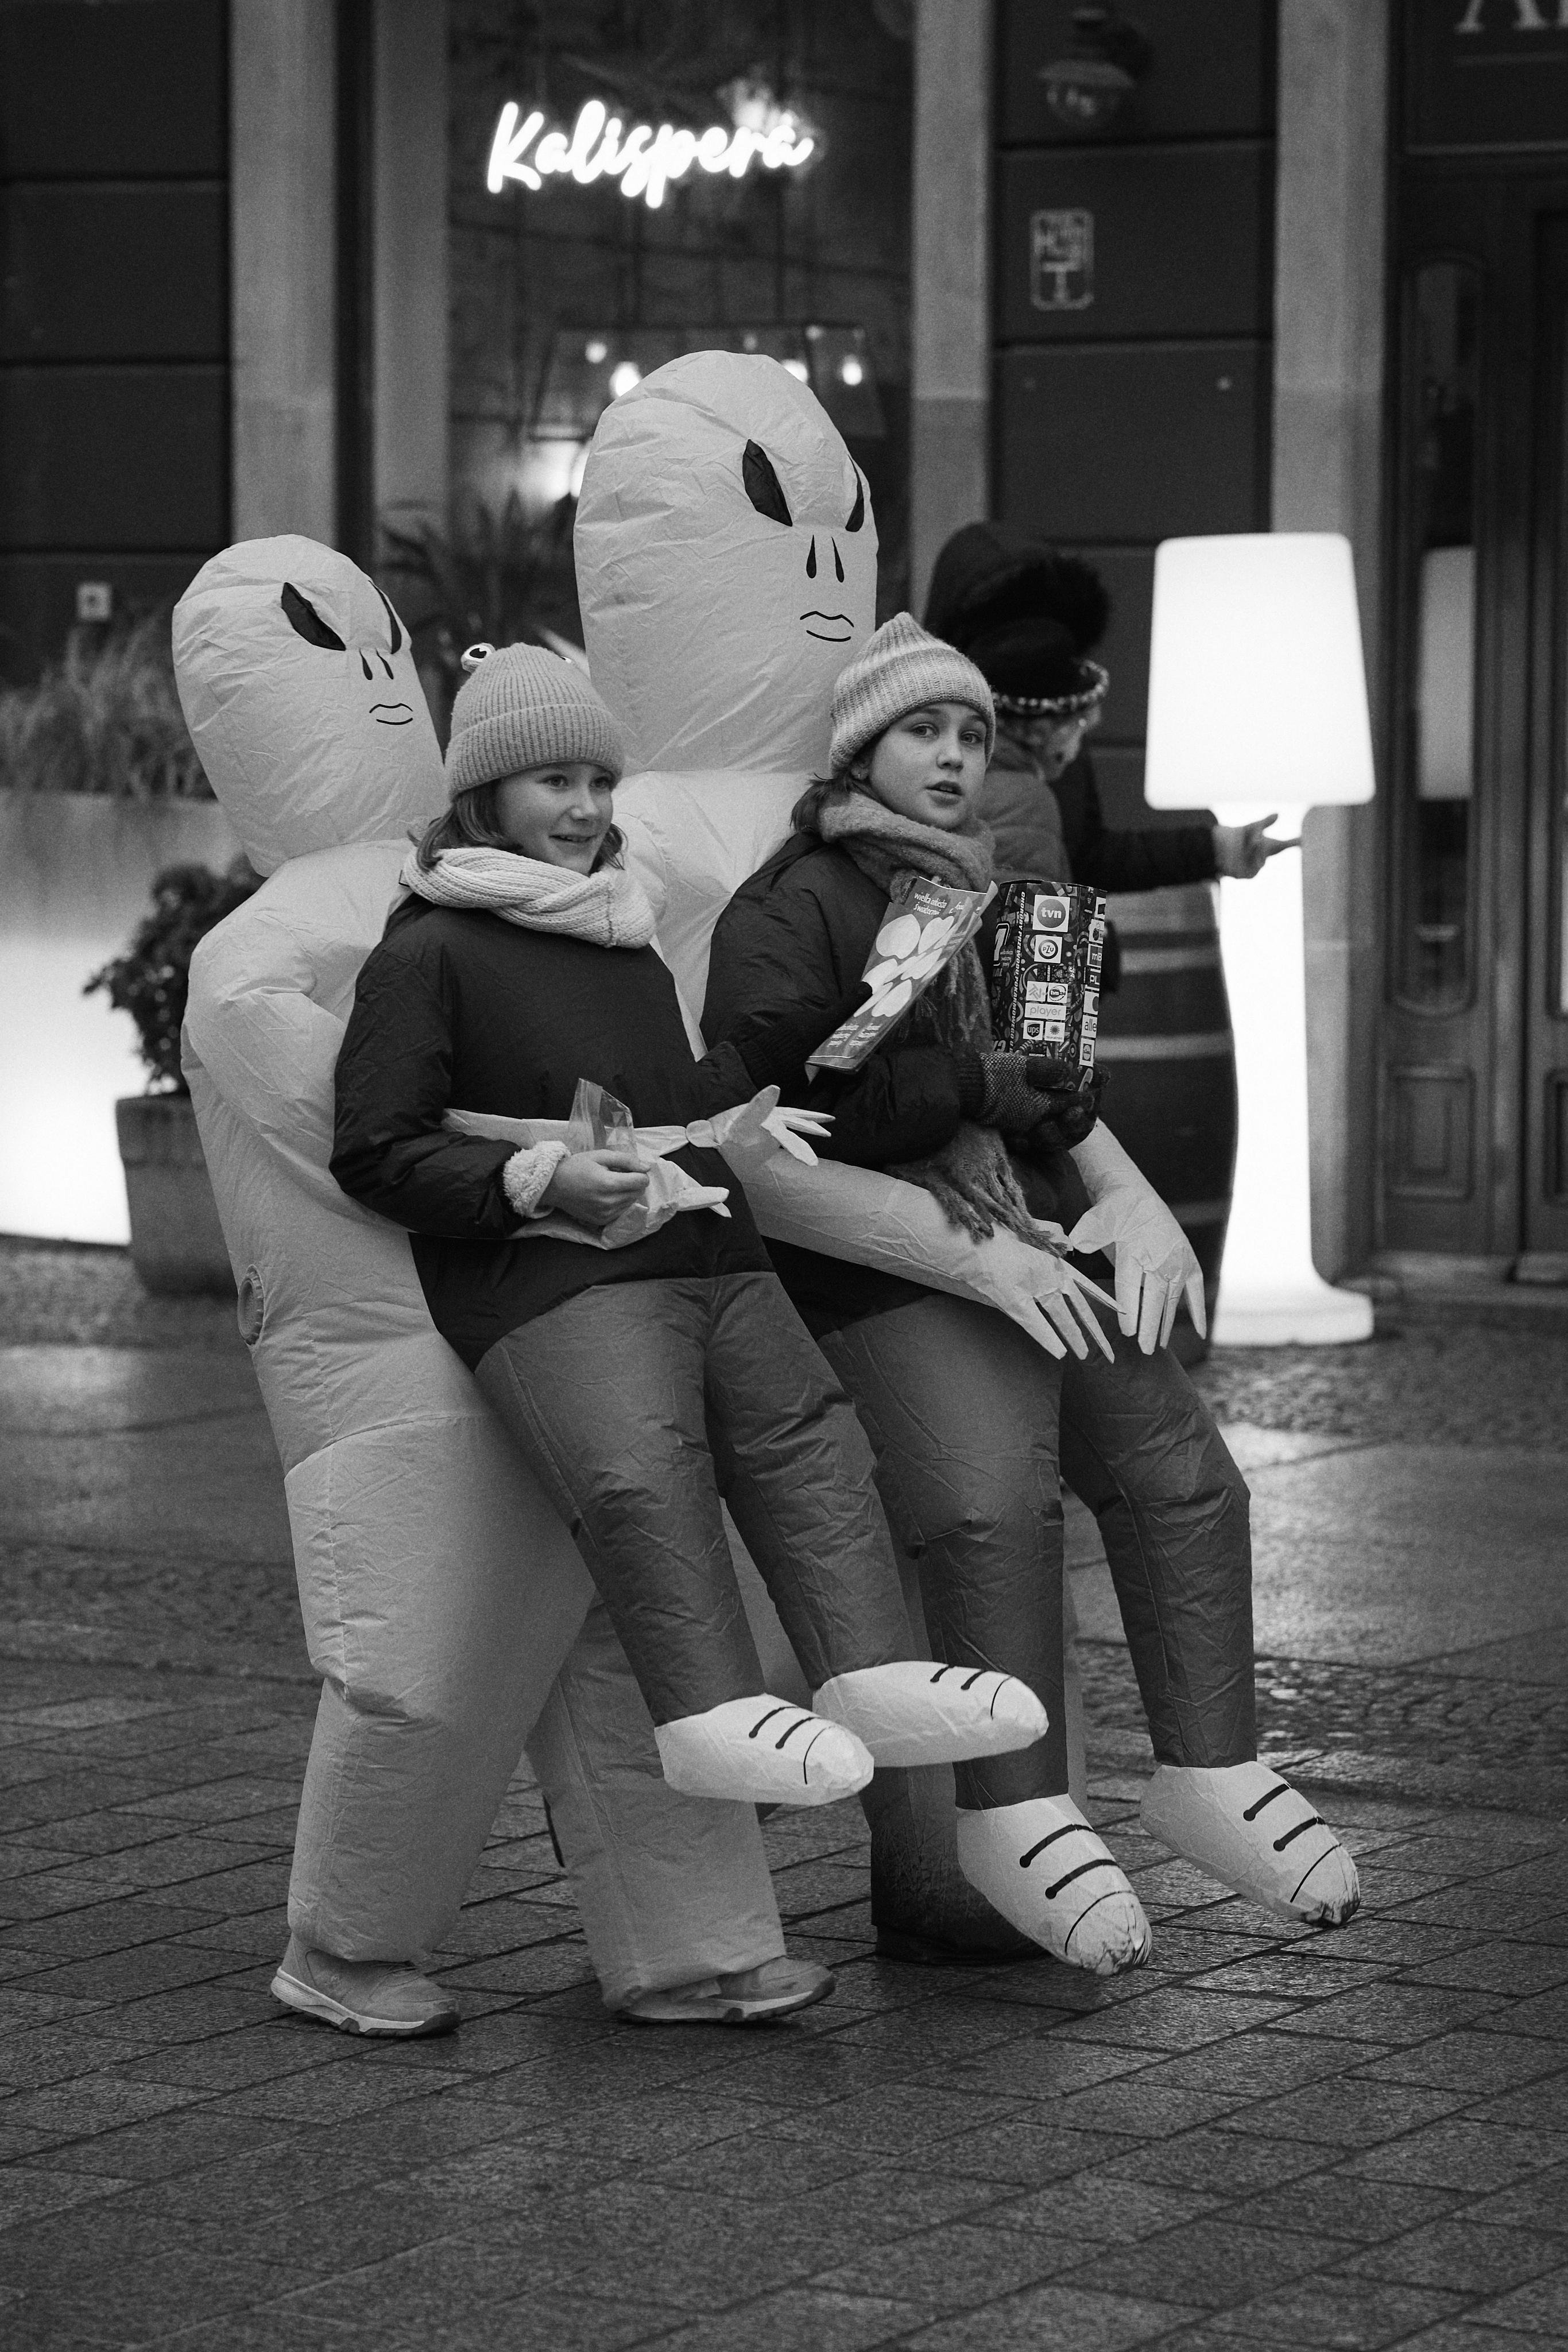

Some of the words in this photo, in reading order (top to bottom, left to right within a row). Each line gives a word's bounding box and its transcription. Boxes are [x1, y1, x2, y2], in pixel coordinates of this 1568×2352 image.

[487, 100, 814, 209] Kalispera
[1041, 907, 1062, 918] tvn
[1043, 945, 1054, 953] PZU
[1029, 1006, 1062, 1016] player
[1028, 1027, 1040, 1035] ups
